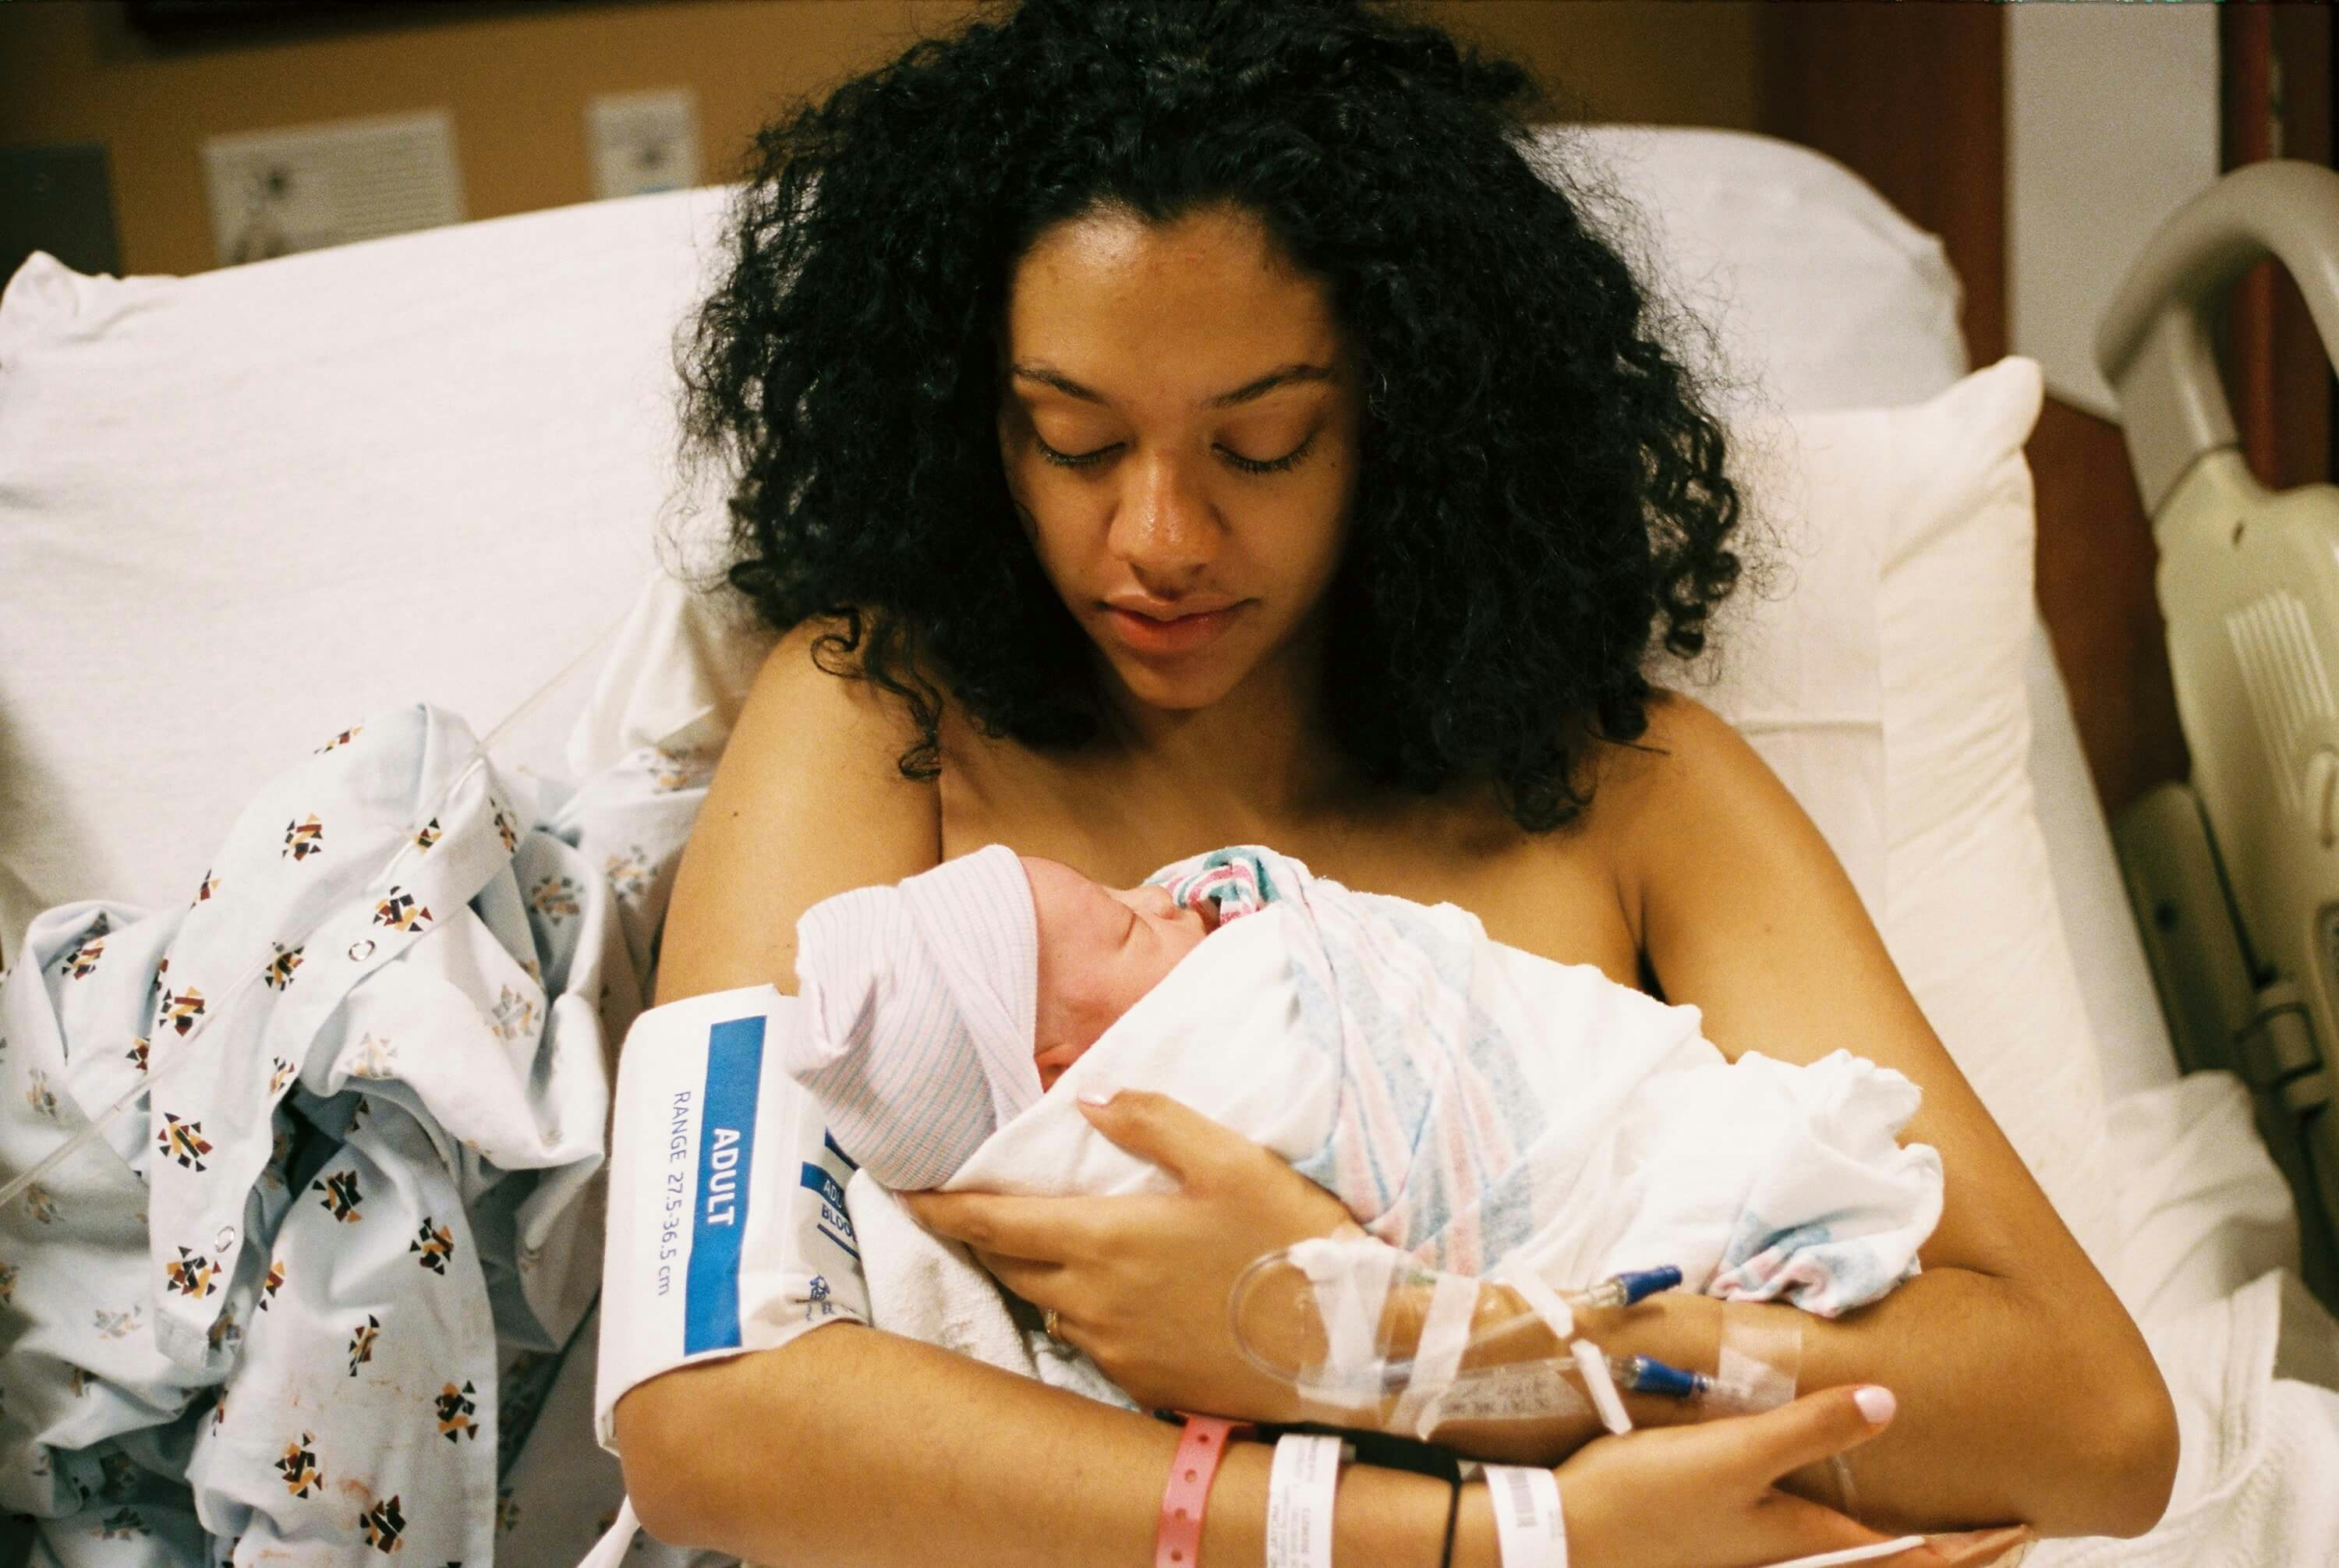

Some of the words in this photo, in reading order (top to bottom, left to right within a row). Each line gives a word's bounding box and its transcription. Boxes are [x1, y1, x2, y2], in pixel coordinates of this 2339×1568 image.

[670, 1091, 691, 1163] RANGE
[708, 1127, 741, 1226] ADULT
[823, 1178, 843, 1209] ADU
[660, 1172, 684, 1261] 27.5-36.5
[658, 1265, 671, 1297] cm
